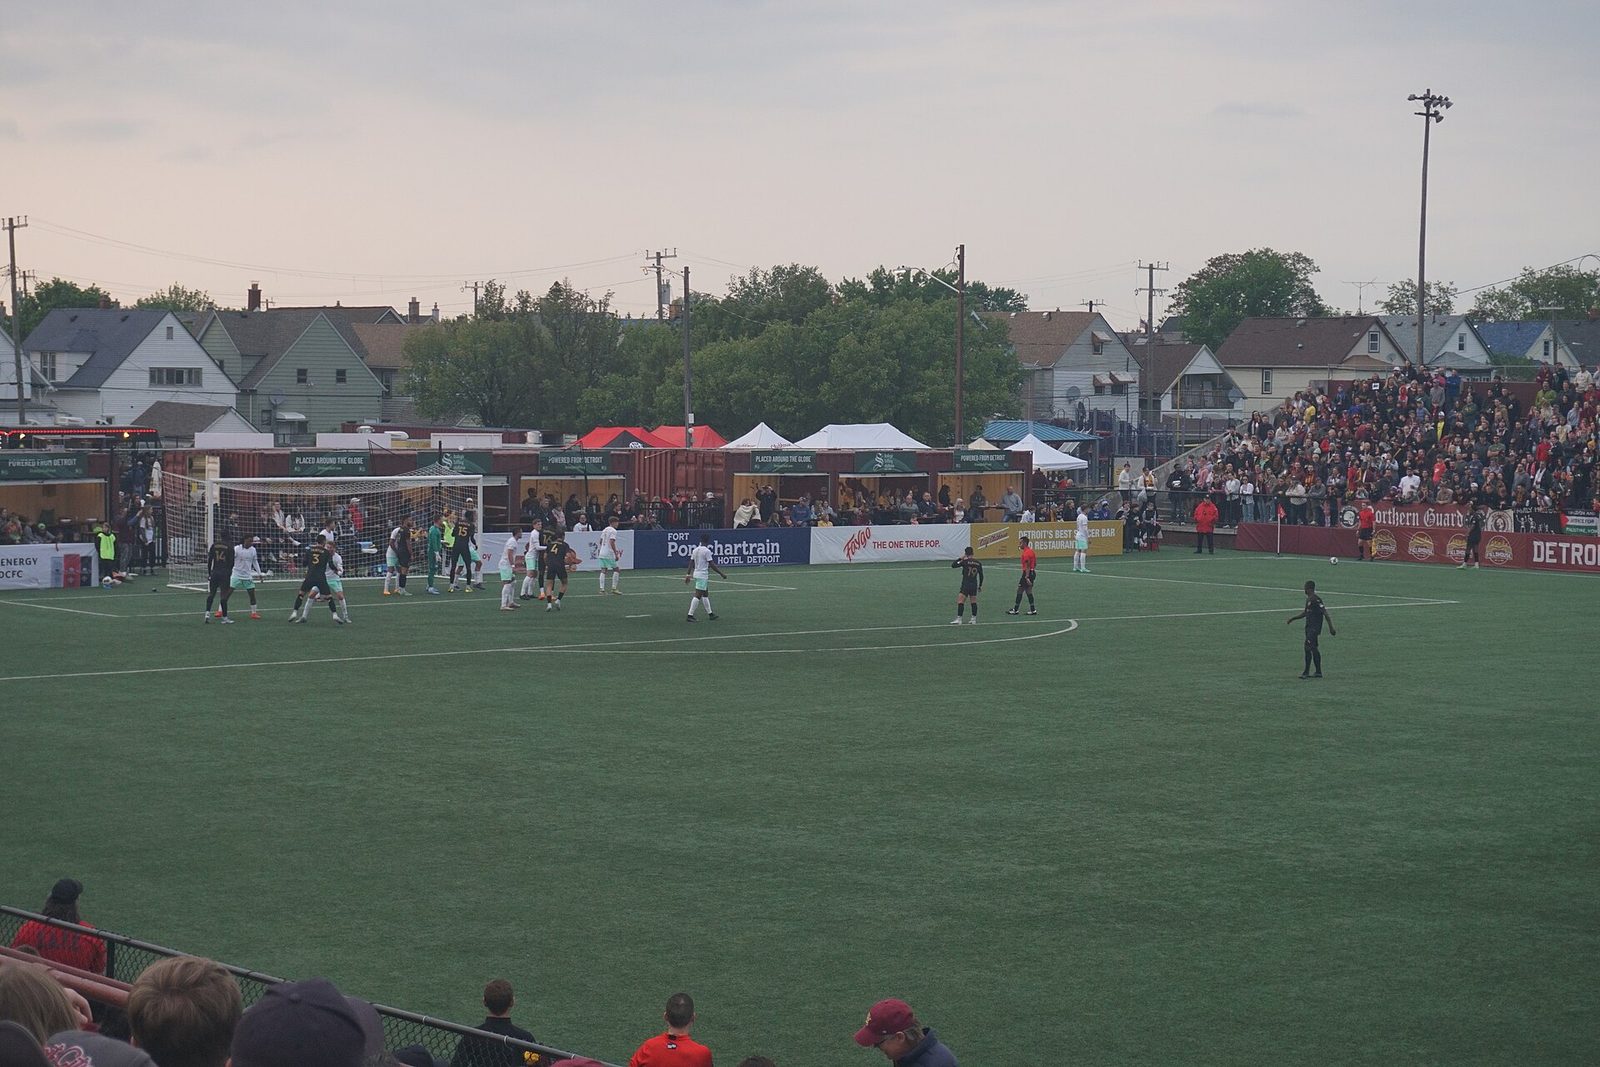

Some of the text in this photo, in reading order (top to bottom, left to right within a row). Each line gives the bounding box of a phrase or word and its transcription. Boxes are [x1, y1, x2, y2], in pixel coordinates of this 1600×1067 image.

[295, 456, 316, 464] PLACED
[316, 456, 337, 464] AROUND
[337, 456, 347, 464] THE
[1374, 506, 1420, 528] orthern
[1423, 507, 1465, 528] Guard
[458, 525, 468, 537] 15
[667, 532, 690, 541] FORT
[1018, 529, 1053, 540] DETROIT'S
[1055, 529, 1072, 539] BEST
[1073, 528, 1100, 538] SCER
[1101, 528, 1116, 537] BAR
[550, 543, 559, 556] 4
[667, 538, 780, 557] Ponchartrain
[843, 526, 872, 562] Faygo
[872, 539, 941, 550] THE ONE TRUE POP.
[312, 553, 320, 565] 3
[717, 554, 780, 565] HOTEL DETROIT
